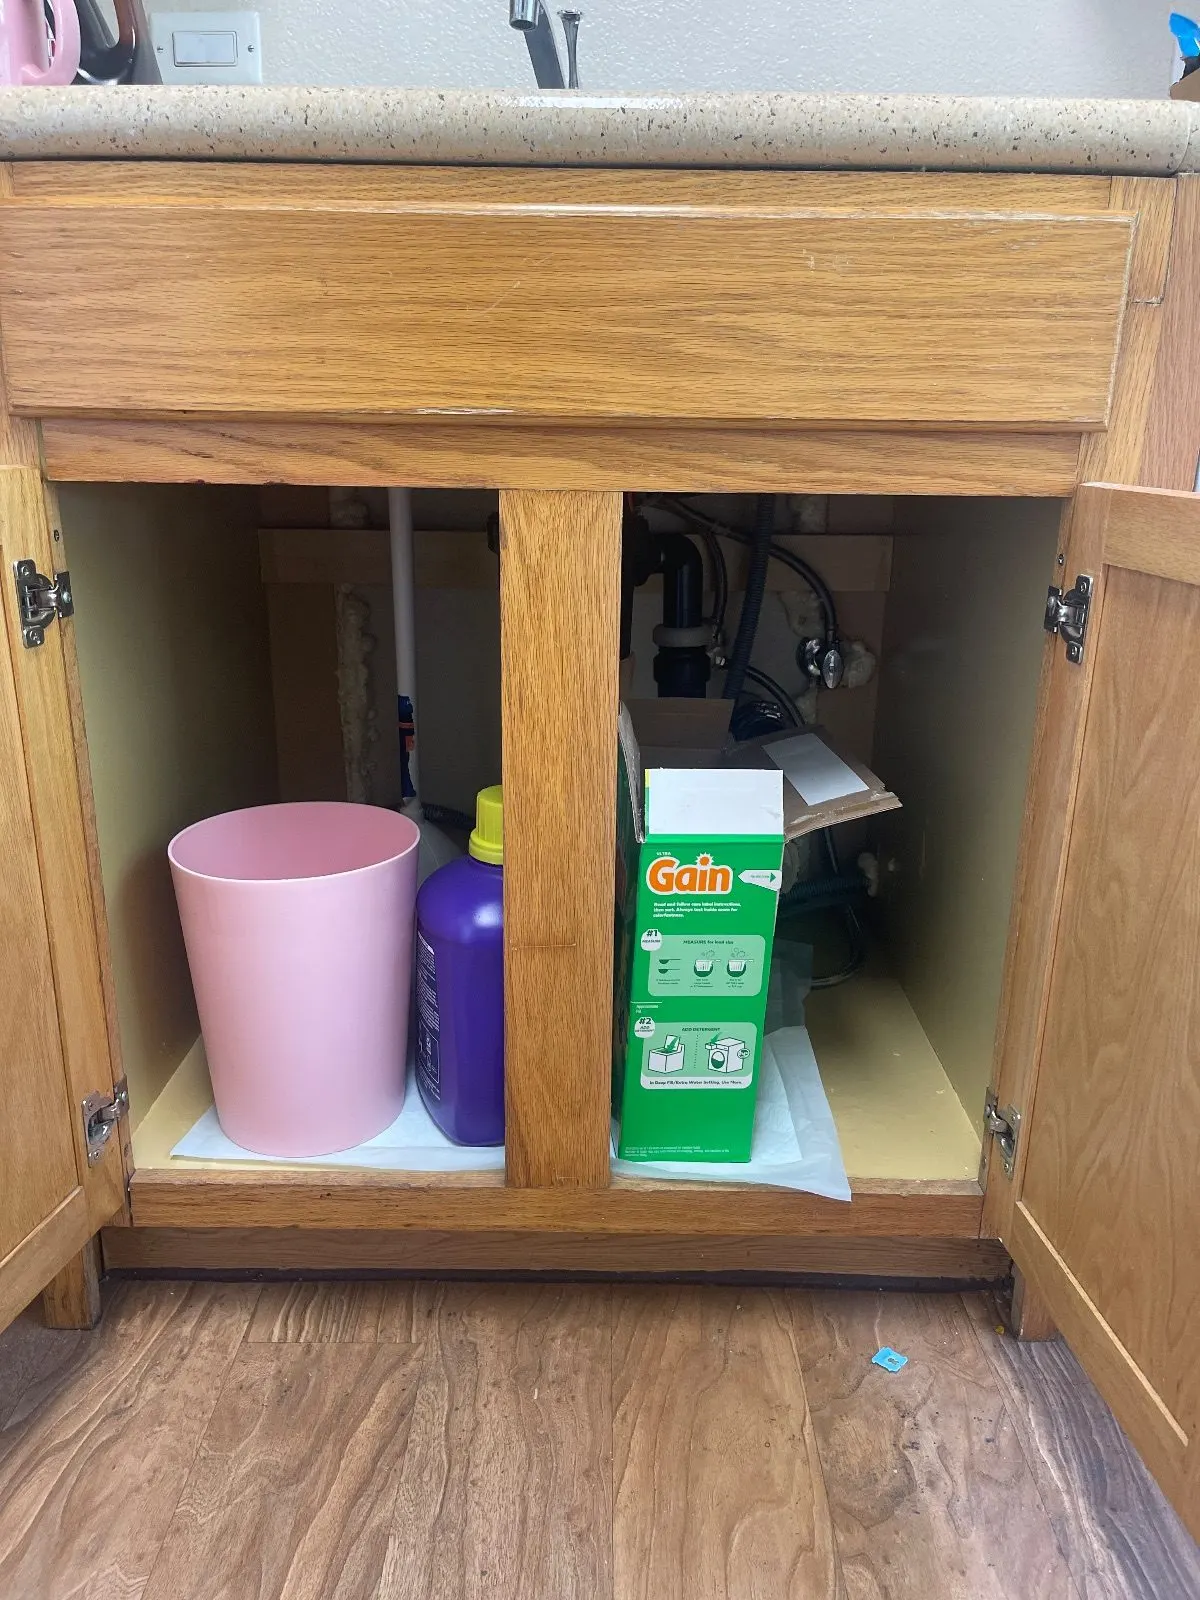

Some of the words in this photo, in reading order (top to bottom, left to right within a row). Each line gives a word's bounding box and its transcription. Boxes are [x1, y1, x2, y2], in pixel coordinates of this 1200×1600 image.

[647, 853, 733, 894] Gain
[646, 929, 658, 937] #1
[639, 1017, 651, 1025] #2
